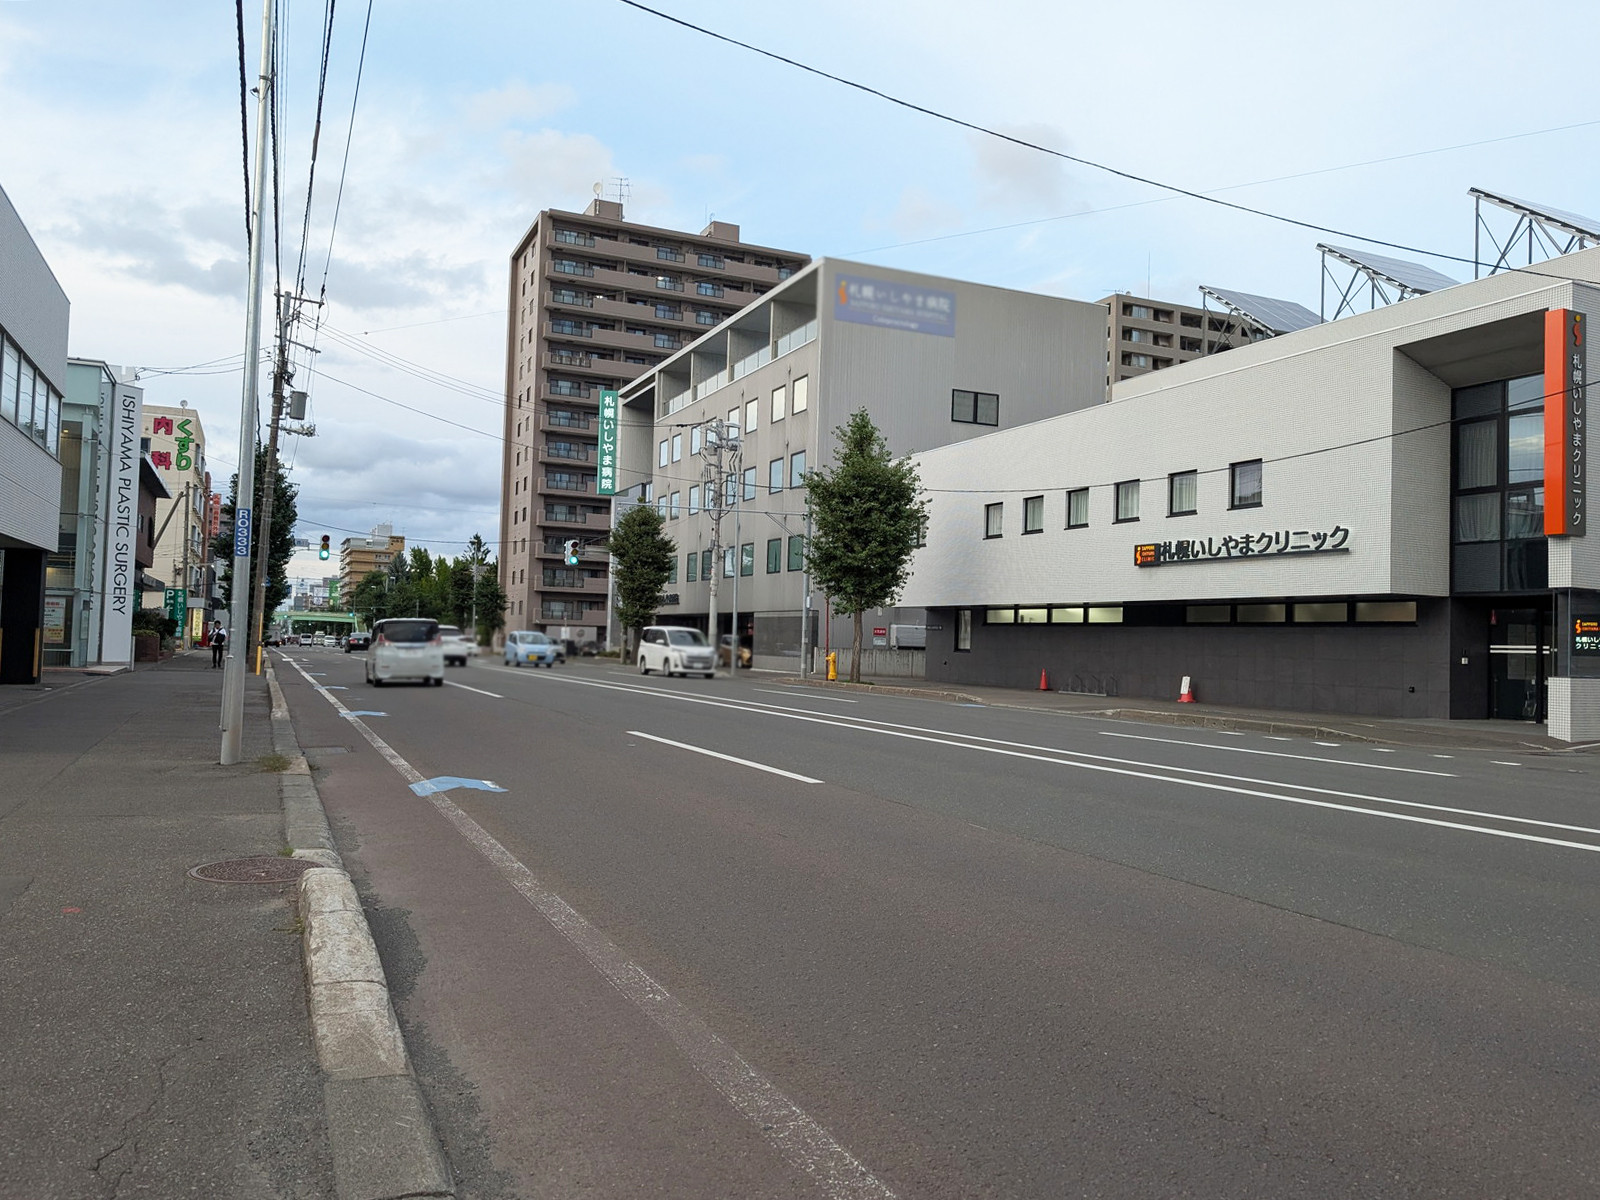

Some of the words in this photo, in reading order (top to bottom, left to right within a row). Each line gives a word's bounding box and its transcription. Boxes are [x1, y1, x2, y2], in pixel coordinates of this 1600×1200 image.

[118, 394, 135, 472] ISHIYAMA
[151, 416, 173, 470] 内科
[175, 418, 194, 471] くすり
[601, 396, 615, 489] 札幌いしやま病院
[1572, 353, 1583, 526] 札幌いしやまクリニック
[114, 478, 131, 538] PLASTIC
[1160, 525, 1350, 561] 札幌いしやまクリニック
[112, 543, 129, 616] SURGERY
